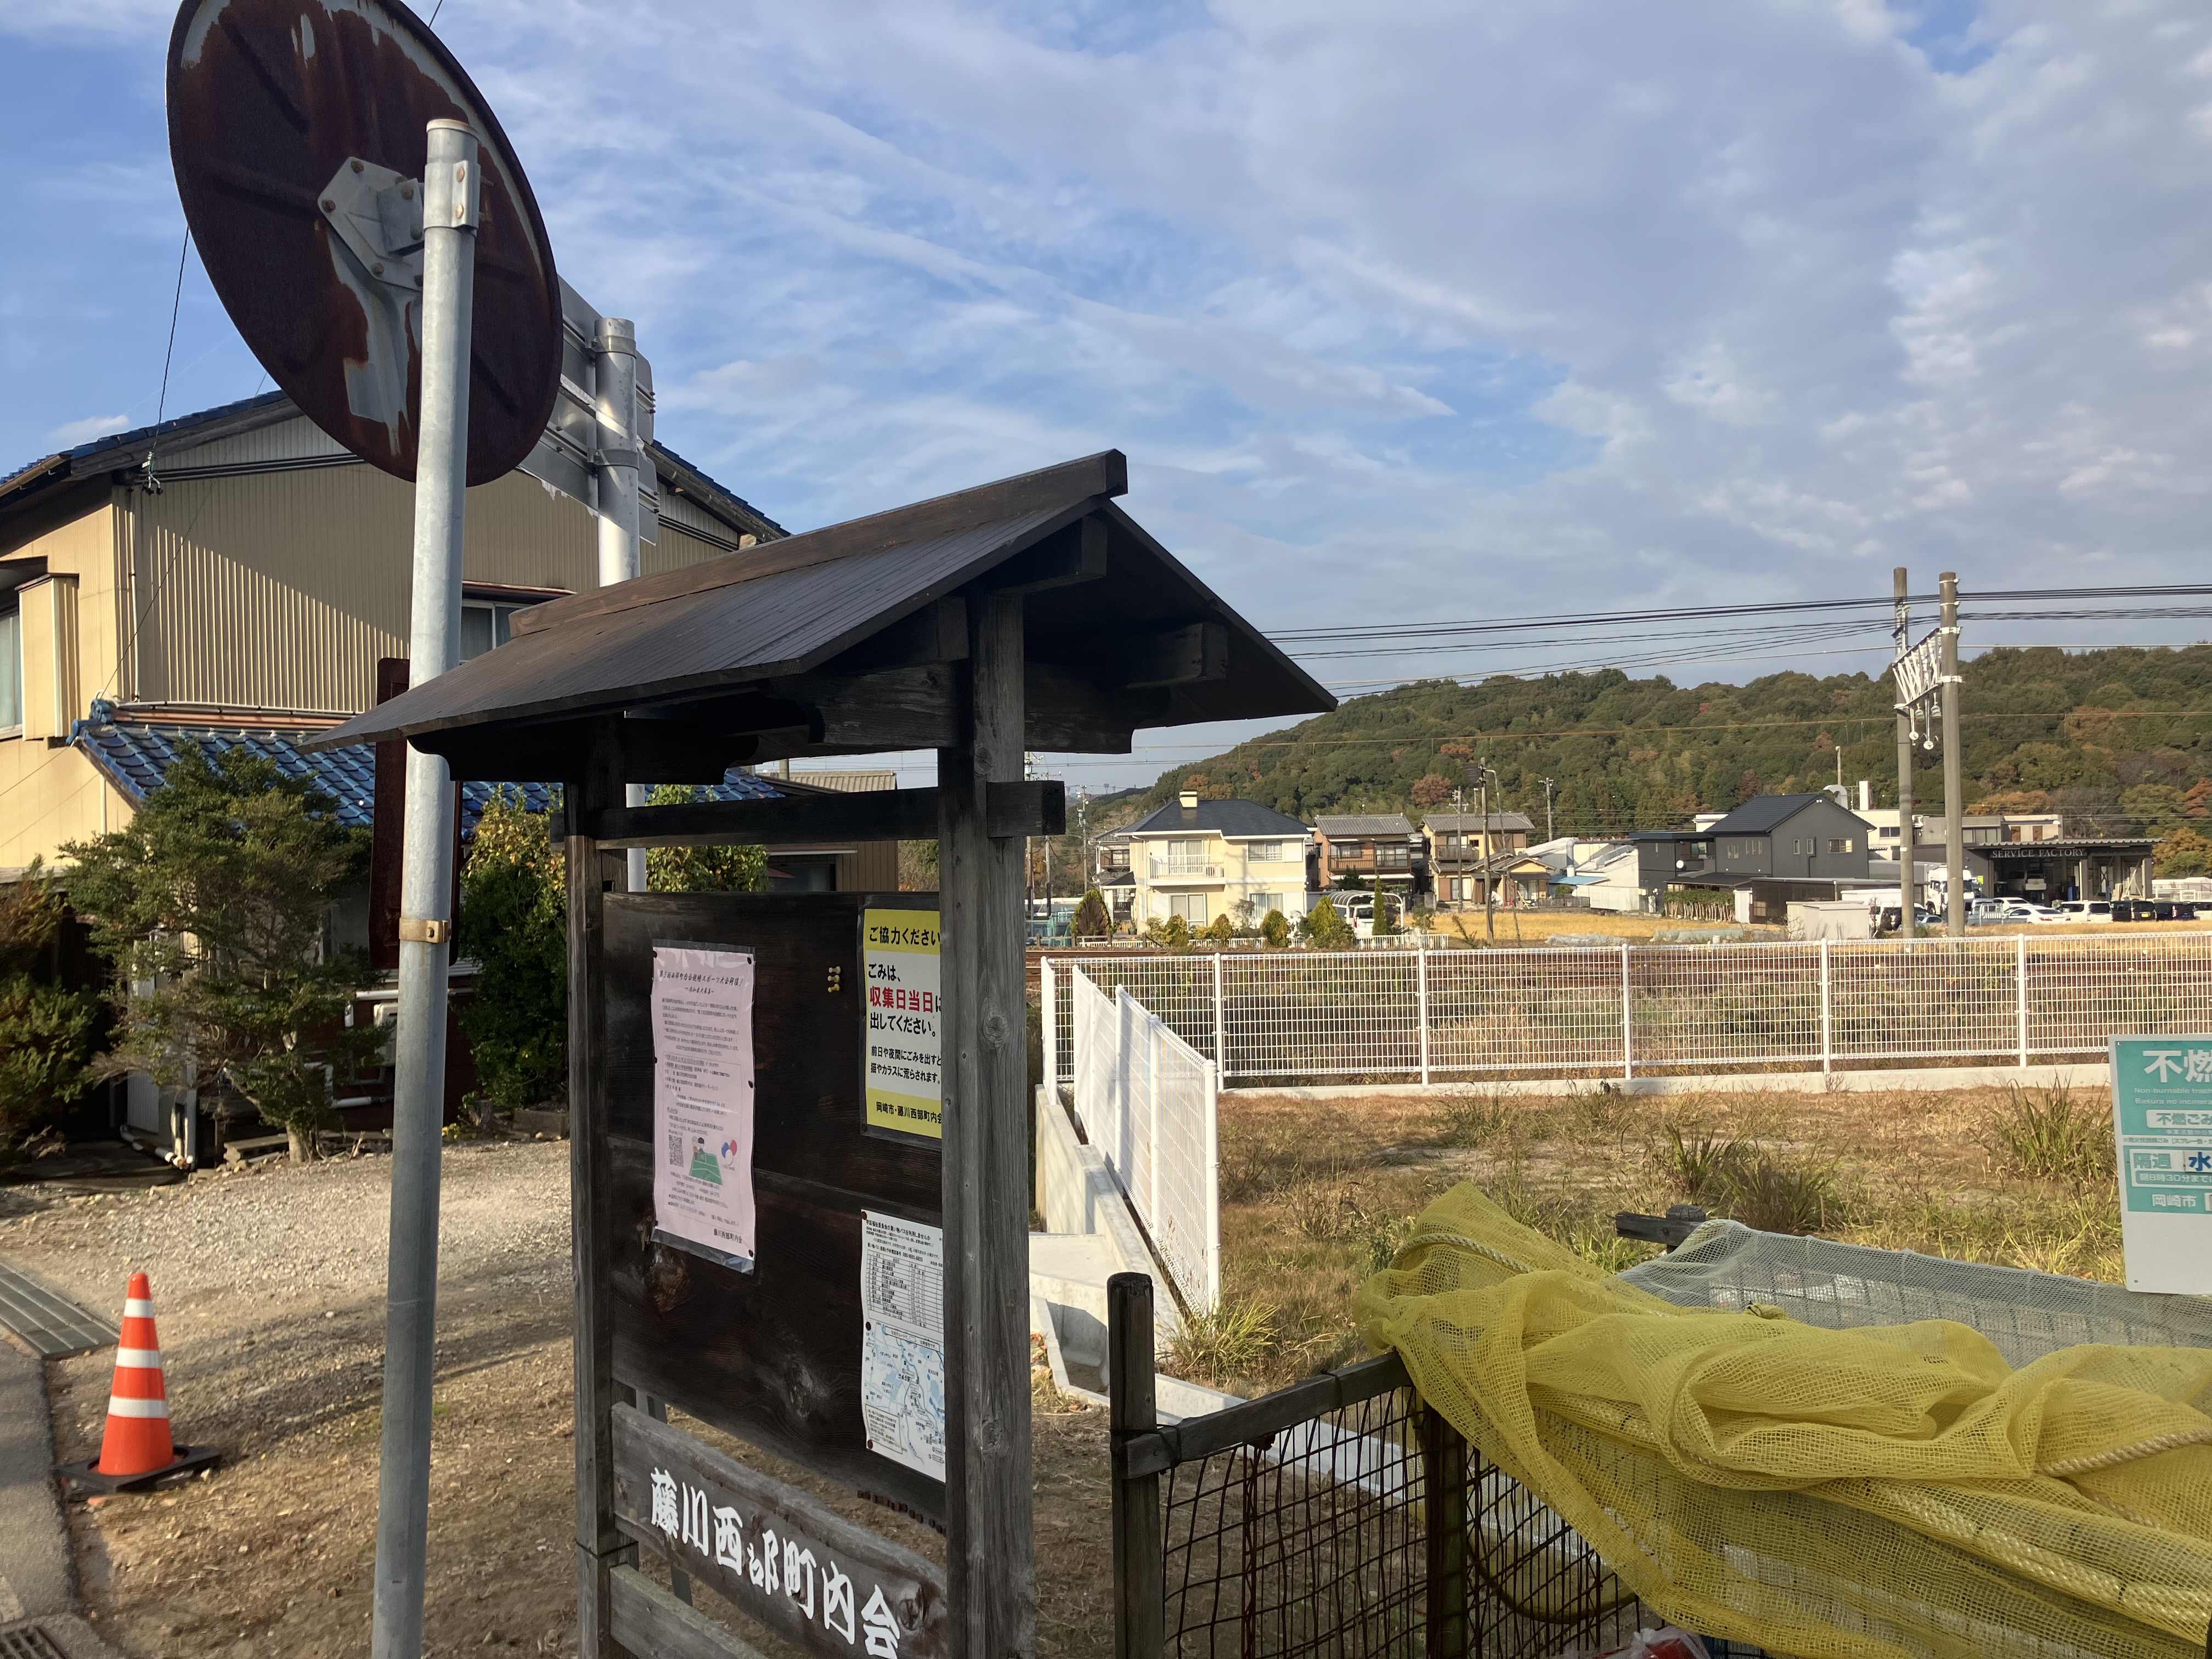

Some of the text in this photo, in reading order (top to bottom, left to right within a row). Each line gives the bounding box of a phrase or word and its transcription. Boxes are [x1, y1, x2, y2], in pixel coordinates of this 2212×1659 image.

[1992, 848, 2086, 857] SERVICE FACTORY
[868, 963, 901, 982] ごみは、
[870, 1012, 936, 1037] 出してください。
[871, 1045, 941, 1066] 前日や夜間にごみを出すと
[871, 1062, 940, 1085] 猫やカラスに荒らされます。
[876, 1101, 941, 1124] 岡崎市・藤川西部町内会
[2133, 1152, 2212, 1172] 隔週 水
[2140, 1173, 2212, 1183] 朝8時30分まで
[2152, 1194, 2197, 1207] 岡崎市
[650, 1467, 900, 1659] 藤川西部町内会
